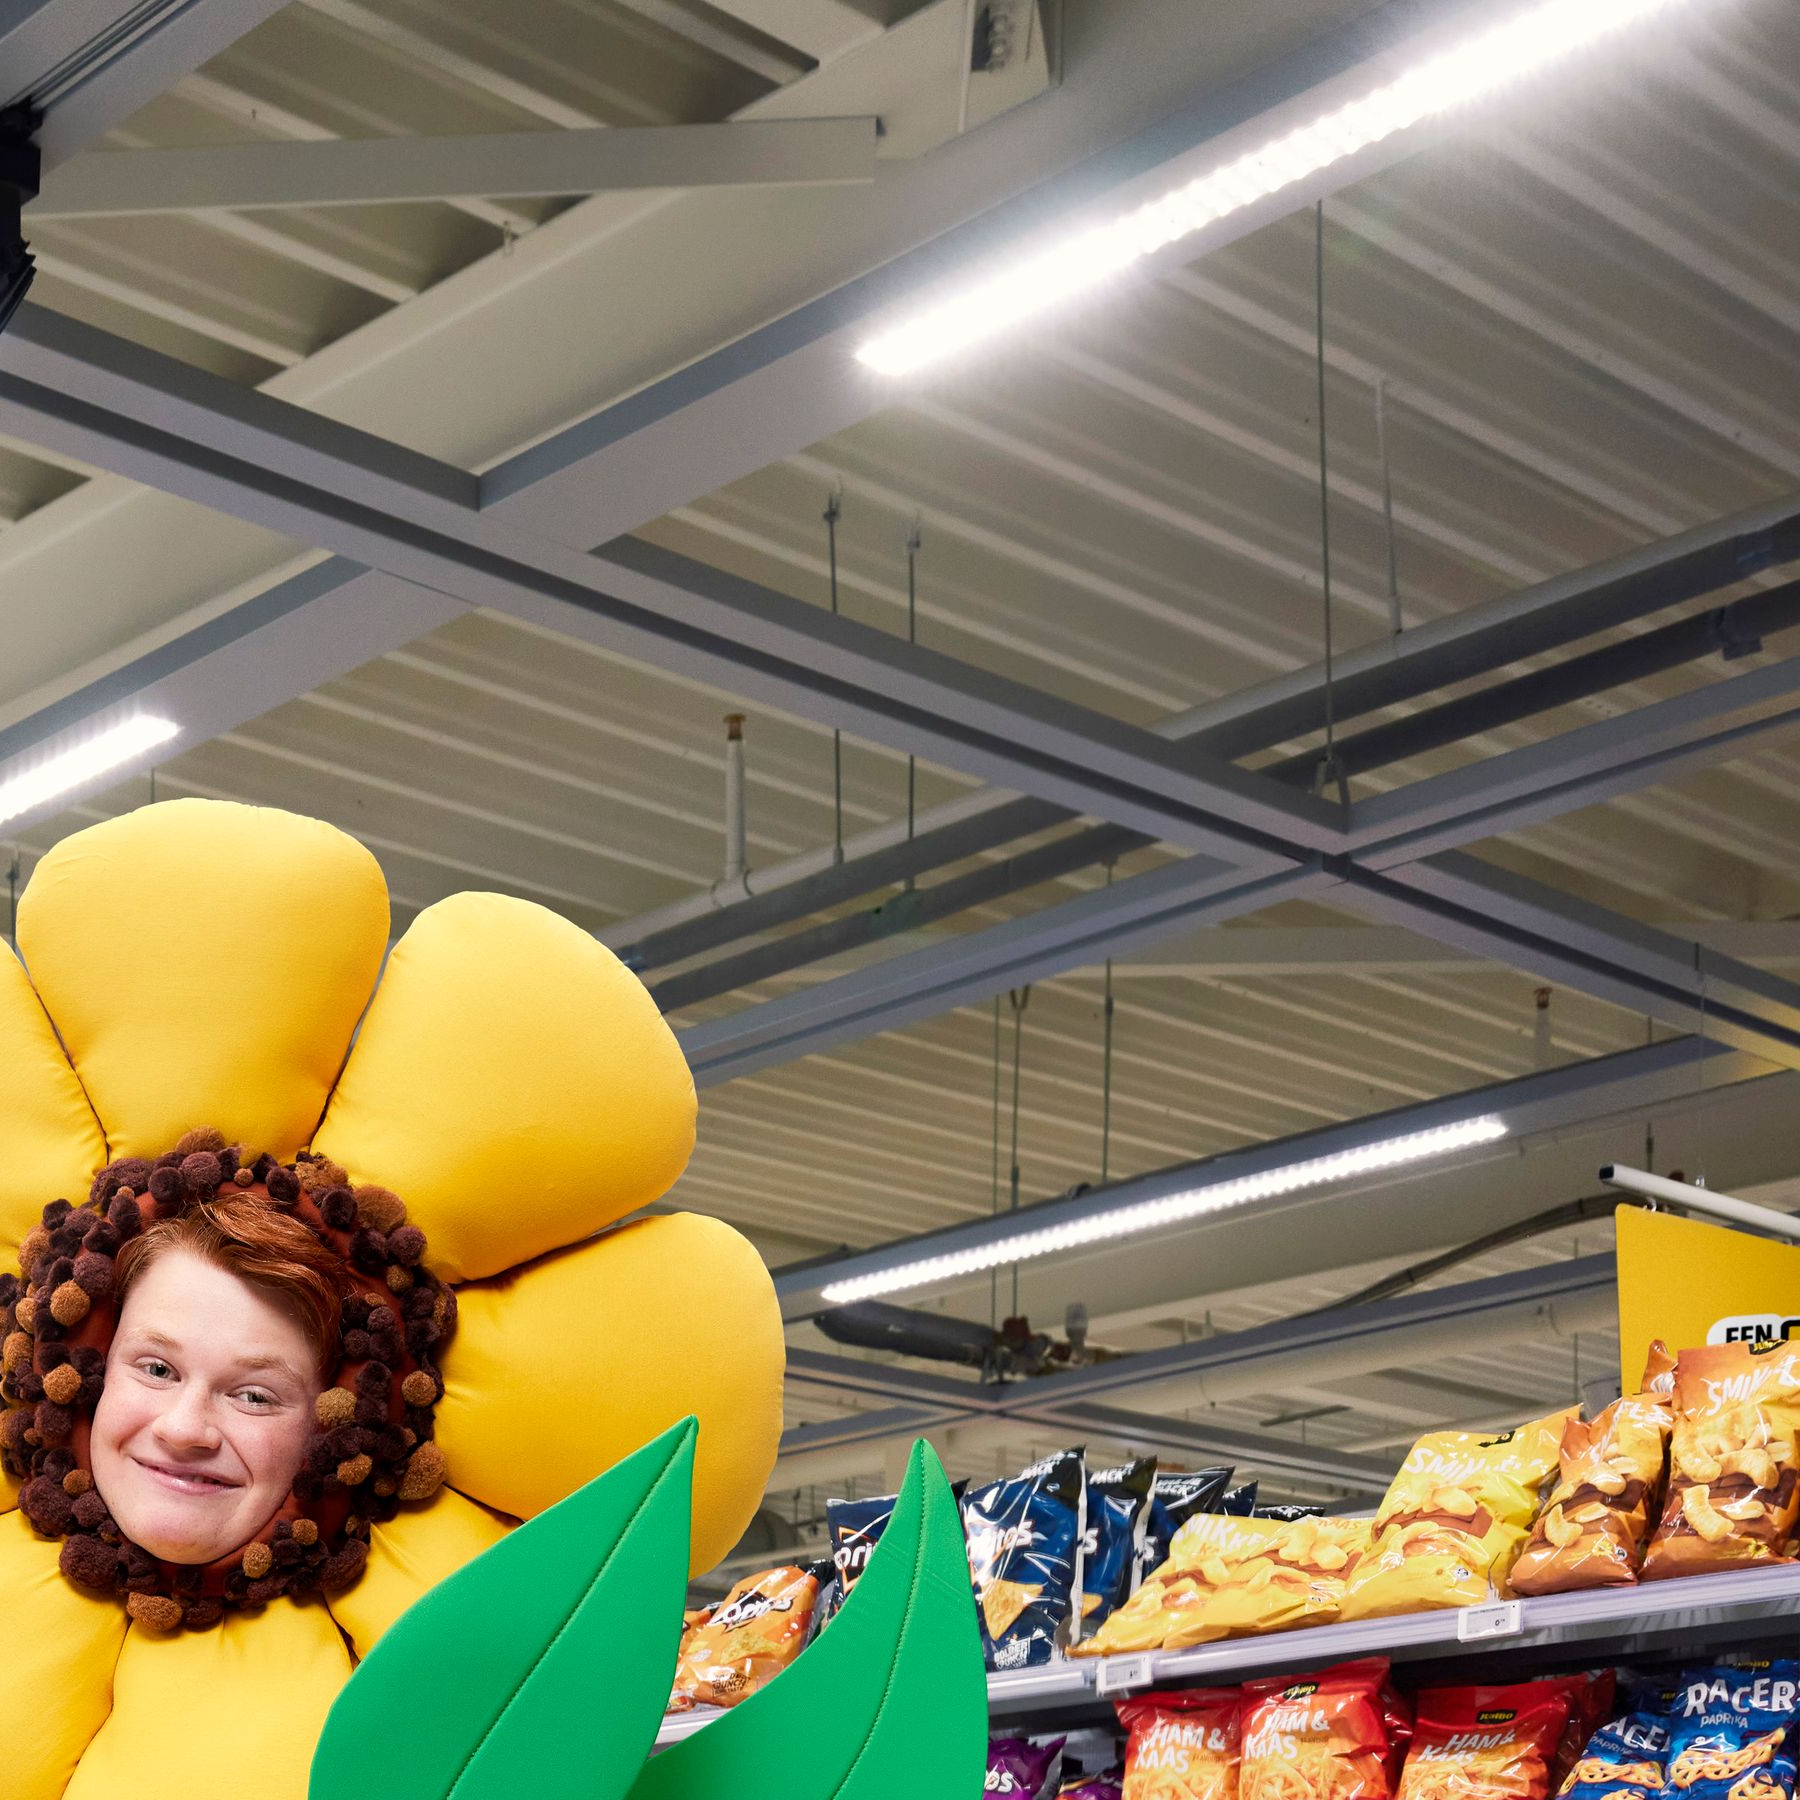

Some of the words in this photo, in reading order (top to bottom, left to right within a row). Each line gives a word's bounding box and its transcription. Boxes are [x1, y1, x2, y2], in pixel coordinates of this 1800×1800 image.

[1683, 1677, 1800, 1718] RACER
[1261, 1708, 1308, 1736] HAM
[1311, 1710, 1330, 1730] &
[1700, 1712, 1749, 1729] PAPRIKA
[1149, 1723, 1204, 1749] HAM
[1206, 1727, 1225, 1750] &
[1245, 1733, 1297, 1760] KAAS
[1446, 1732, 1499, 1752] HAM
[1500, 1730, 1516, 1744] &
[1135, 1743, 1190, 1773] KAAS
